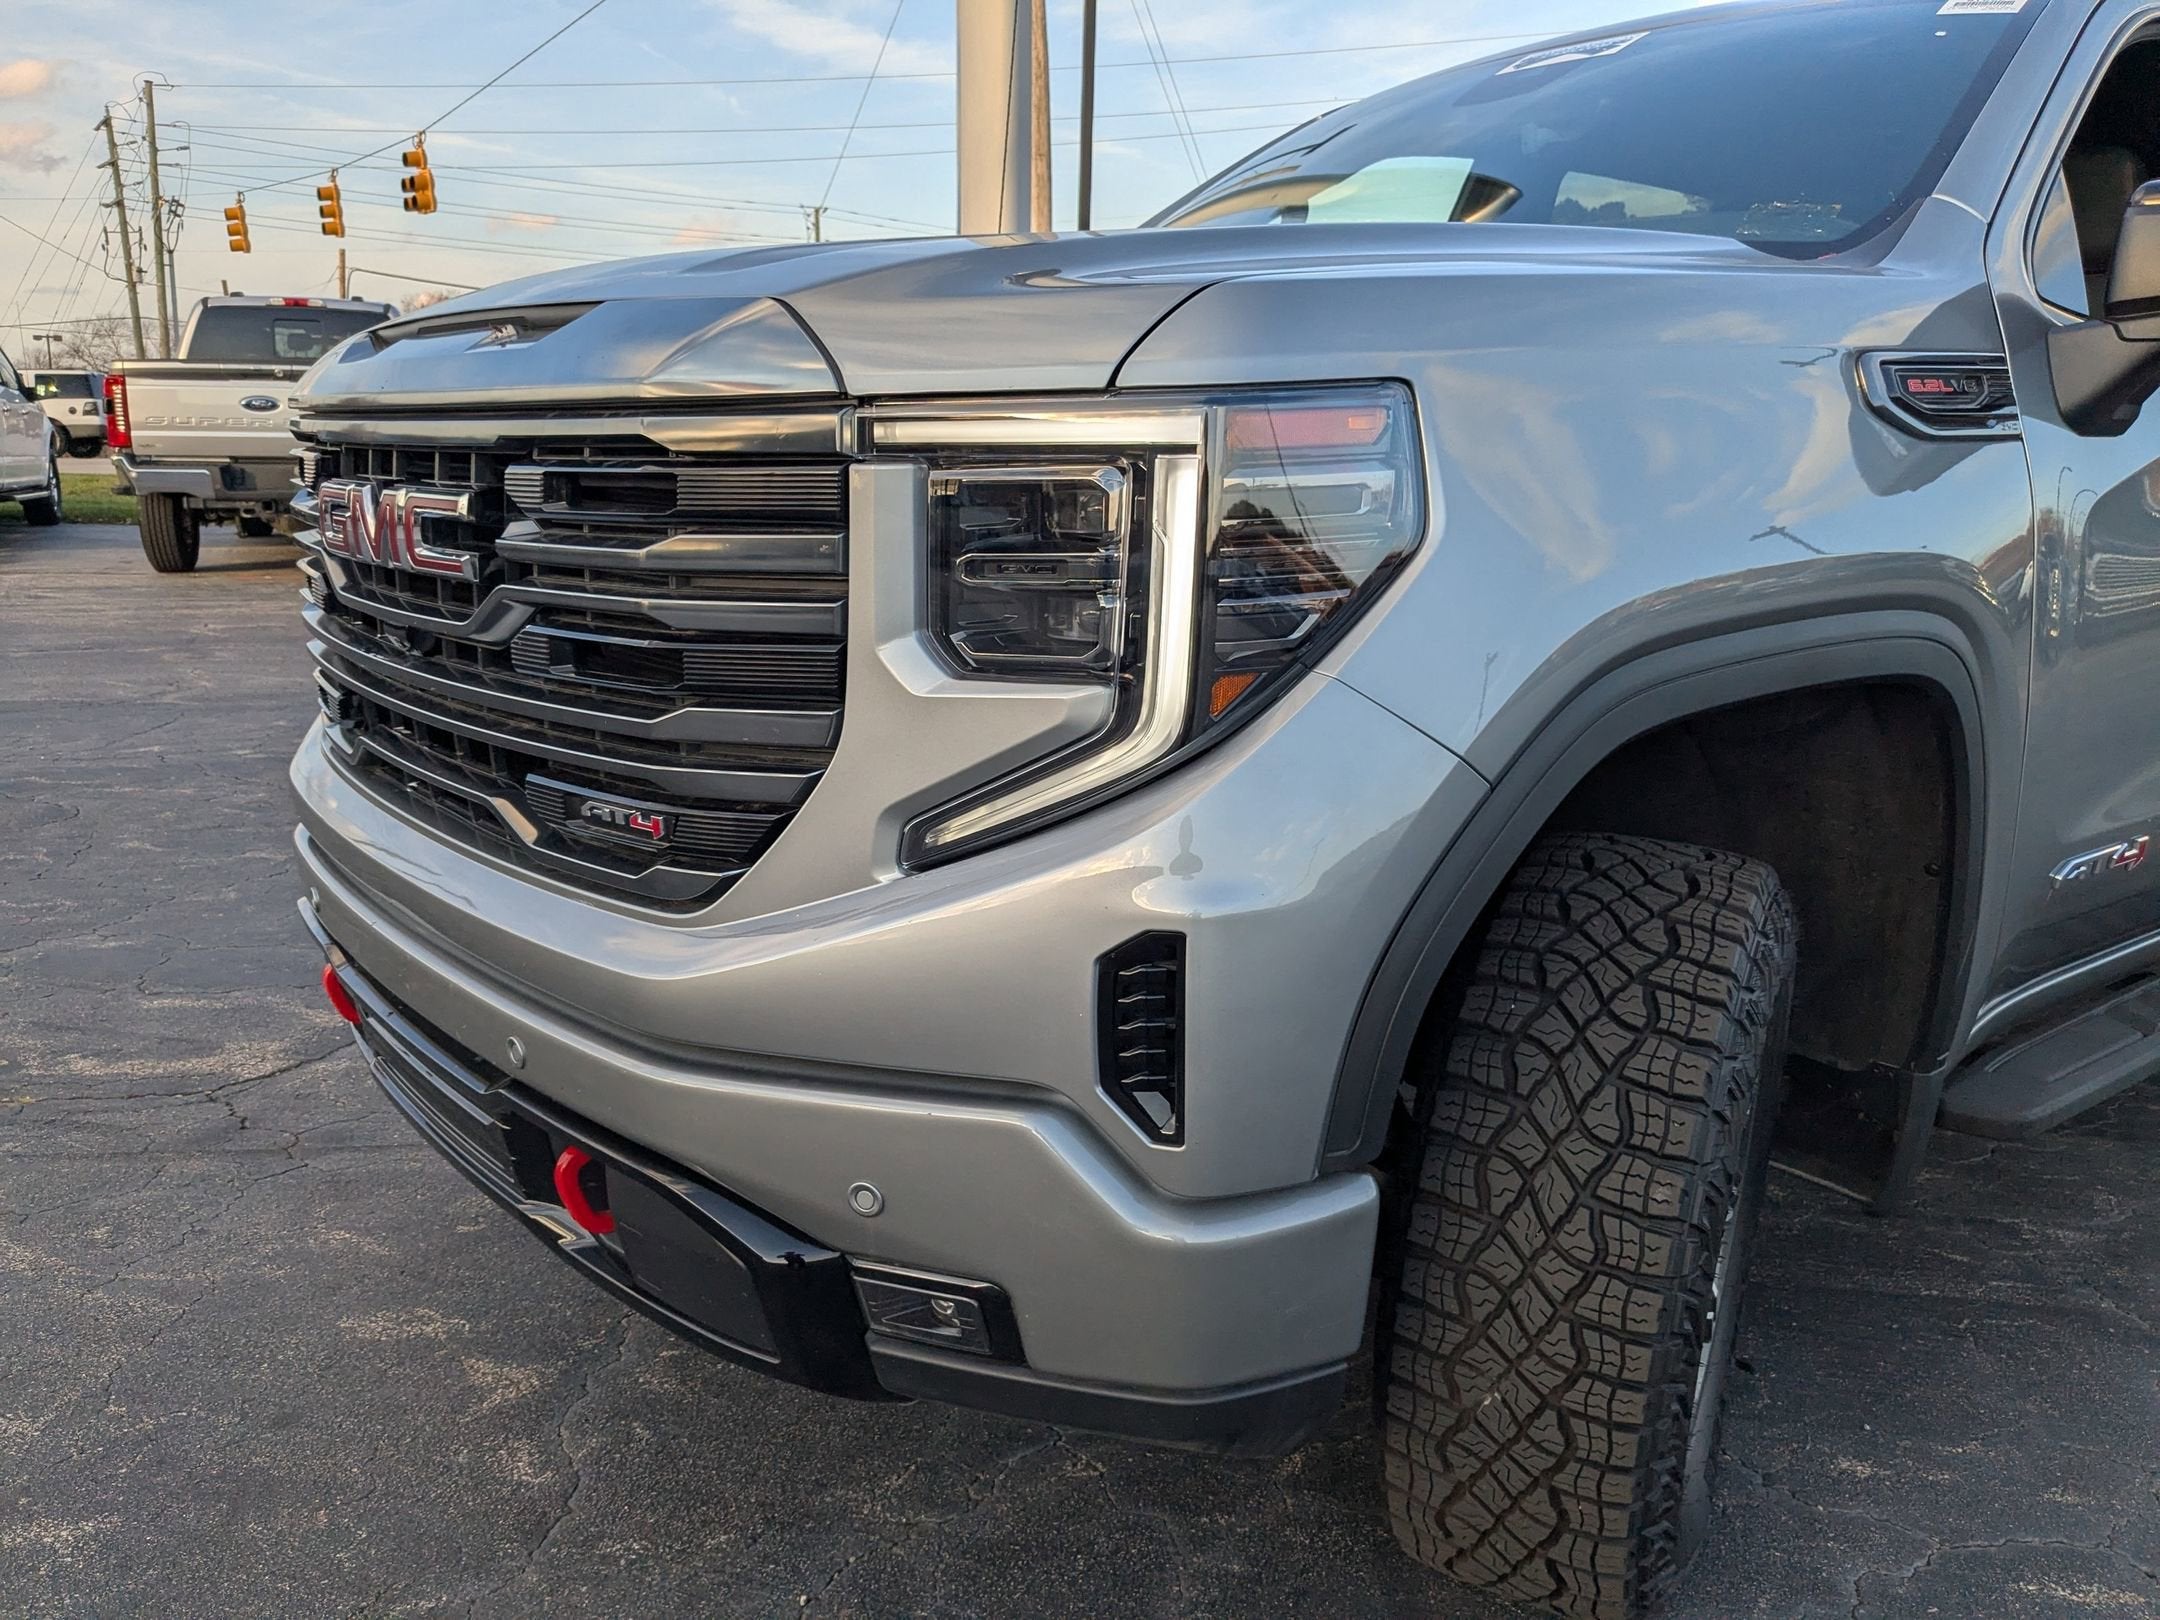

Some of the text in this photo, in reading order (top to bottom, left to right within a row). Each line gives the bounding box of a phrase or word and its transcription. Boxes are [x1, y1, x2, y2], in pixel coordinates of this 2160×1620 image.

[145, 416, 273, 427] SUPER
[319, 482, 471, 576] GMC
[581, 801, 664, 839] AT4
